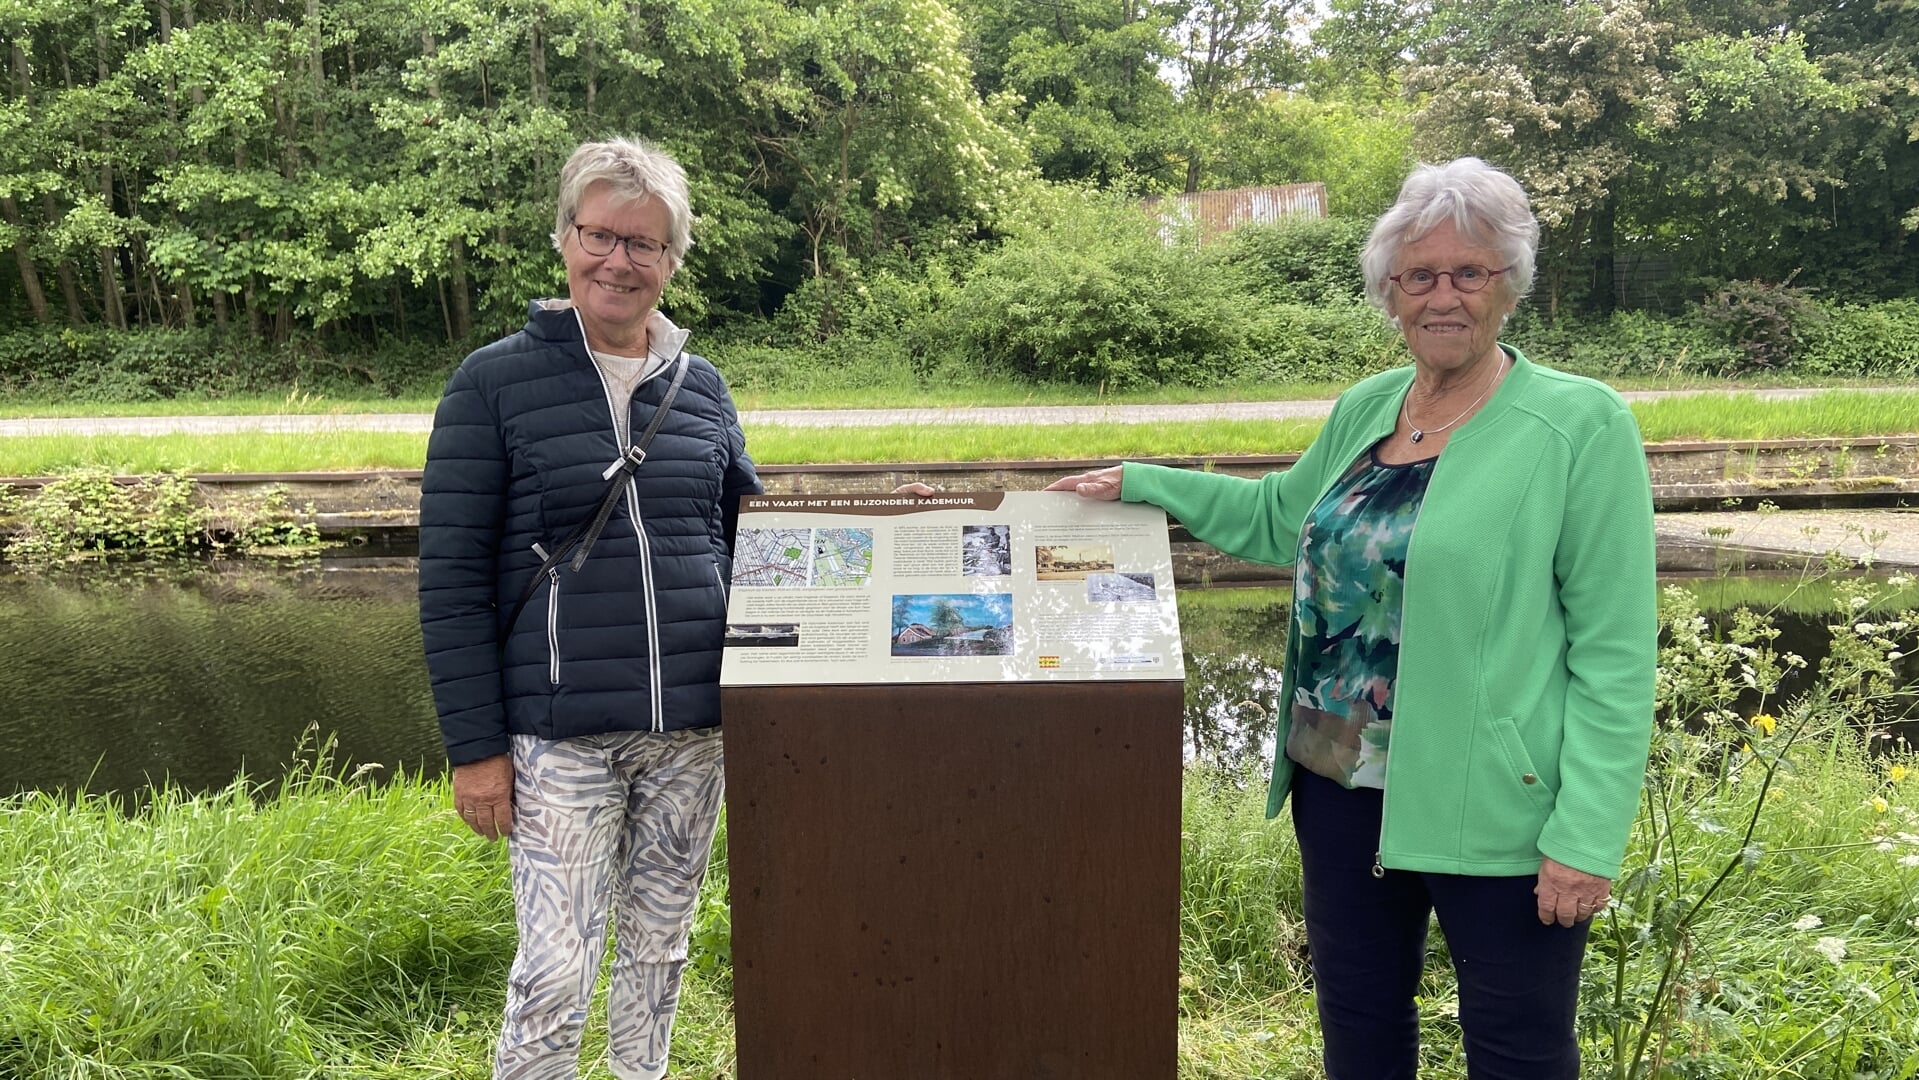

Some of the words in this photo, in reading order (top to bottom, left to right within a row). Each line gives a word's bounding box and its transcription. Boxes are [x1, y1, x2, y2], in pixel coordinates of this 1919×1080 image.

[808, 499, 828, 507] MET
[830, 499, 851, 507] EEN
[853, 498, 915, 506] BIJZONDERE
